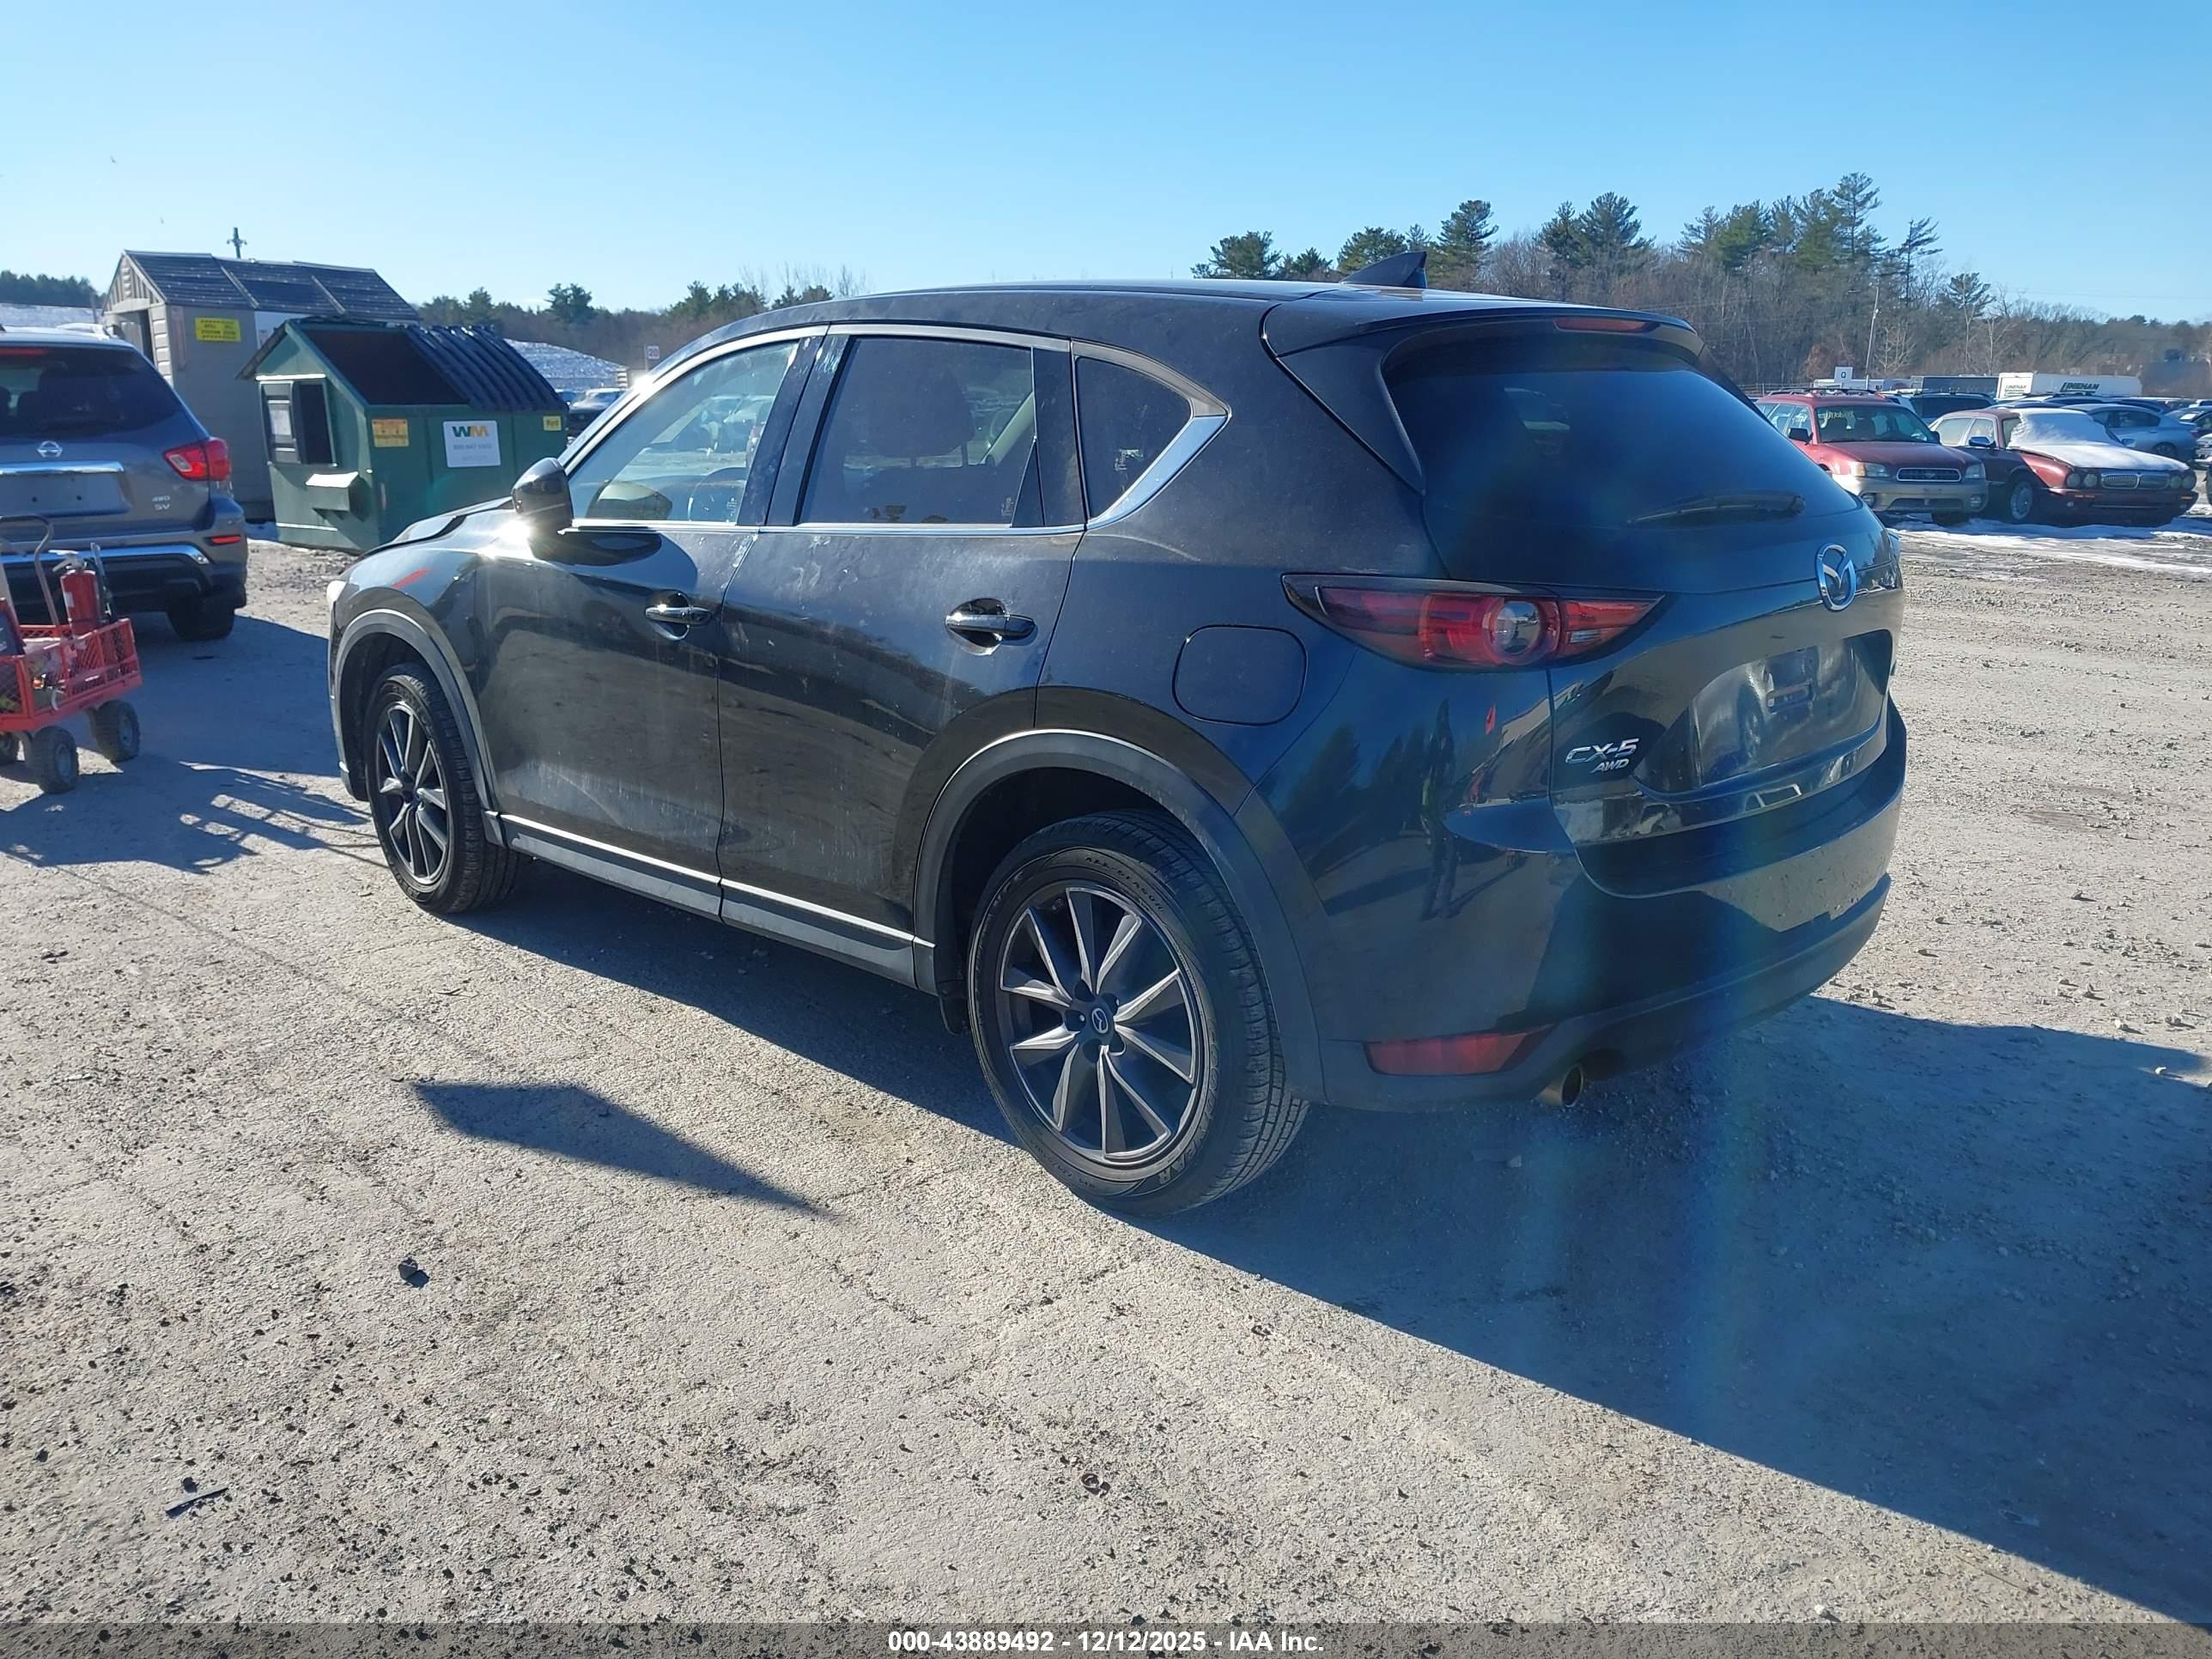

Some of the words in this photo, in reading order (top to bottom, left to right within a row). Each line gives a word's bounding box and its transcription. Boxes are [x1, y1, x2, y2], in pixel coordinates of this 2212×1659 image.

[452, 425, 489, 437] WM
[1565, 738, 1639, 763] CX-5
[1590, 758, 1630, 774] AWD
